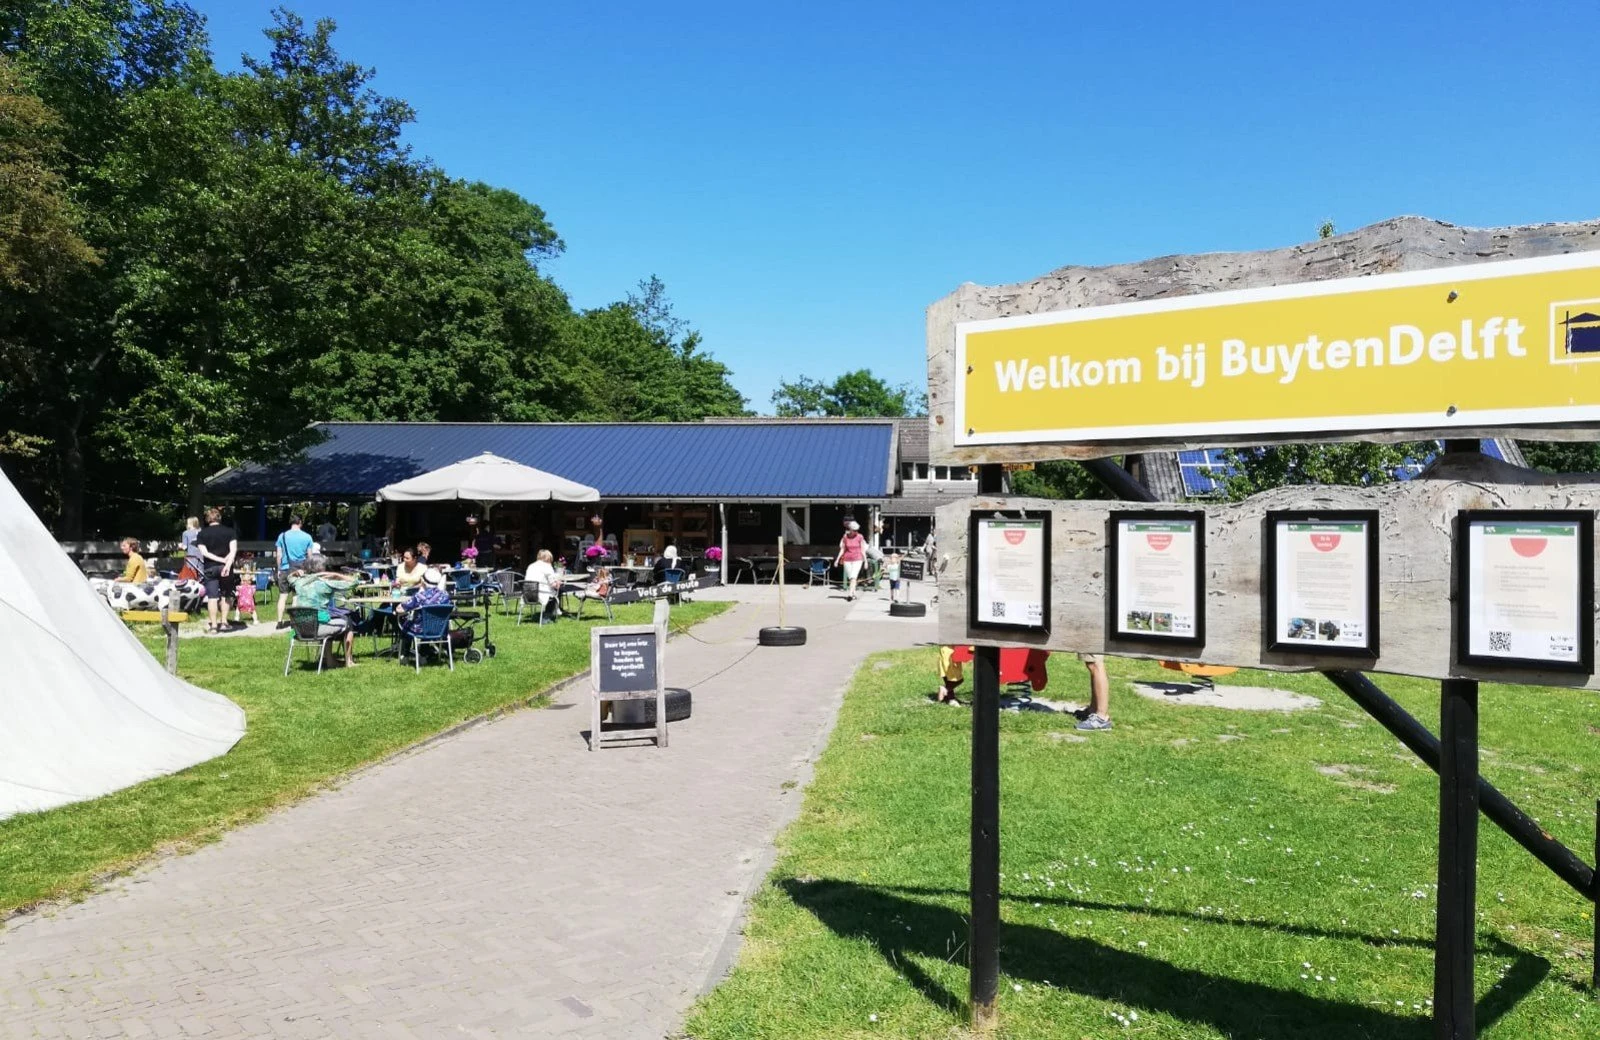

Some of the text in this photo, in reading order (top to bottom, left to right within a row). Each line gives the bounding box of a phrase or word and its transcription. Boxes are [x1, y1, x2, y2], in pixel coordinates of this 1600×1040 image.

[994, 316, 1528, 393] Welkom bij BuytenDelft
[638, 587, 657, 597] Volg
[662, 584, 672, 592] de
[677, 580, 699, 589] route
